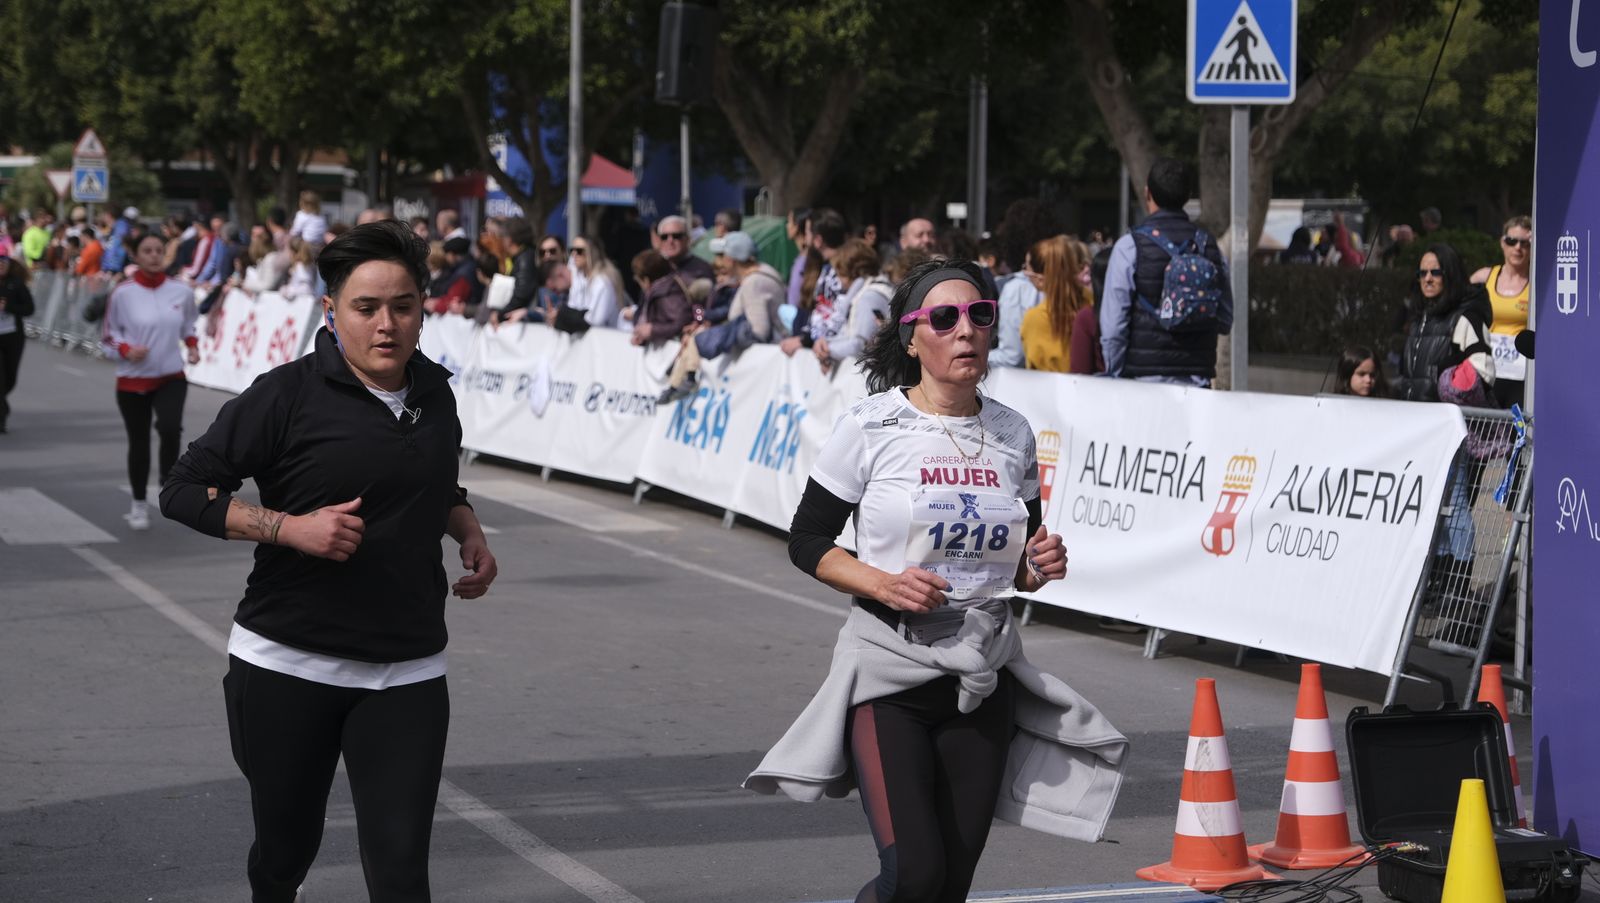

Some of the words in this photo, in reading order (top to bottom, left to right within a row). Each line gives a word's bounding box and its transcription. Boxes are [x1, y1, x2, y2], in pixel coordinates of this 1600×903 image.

[922, 456, 966, 465] CARRERA
[968, 457, 980, 466] DE
[981, 458, 993, 466] LA
[1079, 440, 1207, 503] ALMERÍA
[920, 467, 1001, 488] MUJER
[928, 503, 956, 511] MUJER
[1269, 460, 1425, 527] ALMERÍA
[1072, 495, 1136, 533] CIUDAD
[928, 521, 1010, 551] 1218
[1266, 523, 1341, 562] CIUDAD
[944, 550, 984, 559] ENCARNI
